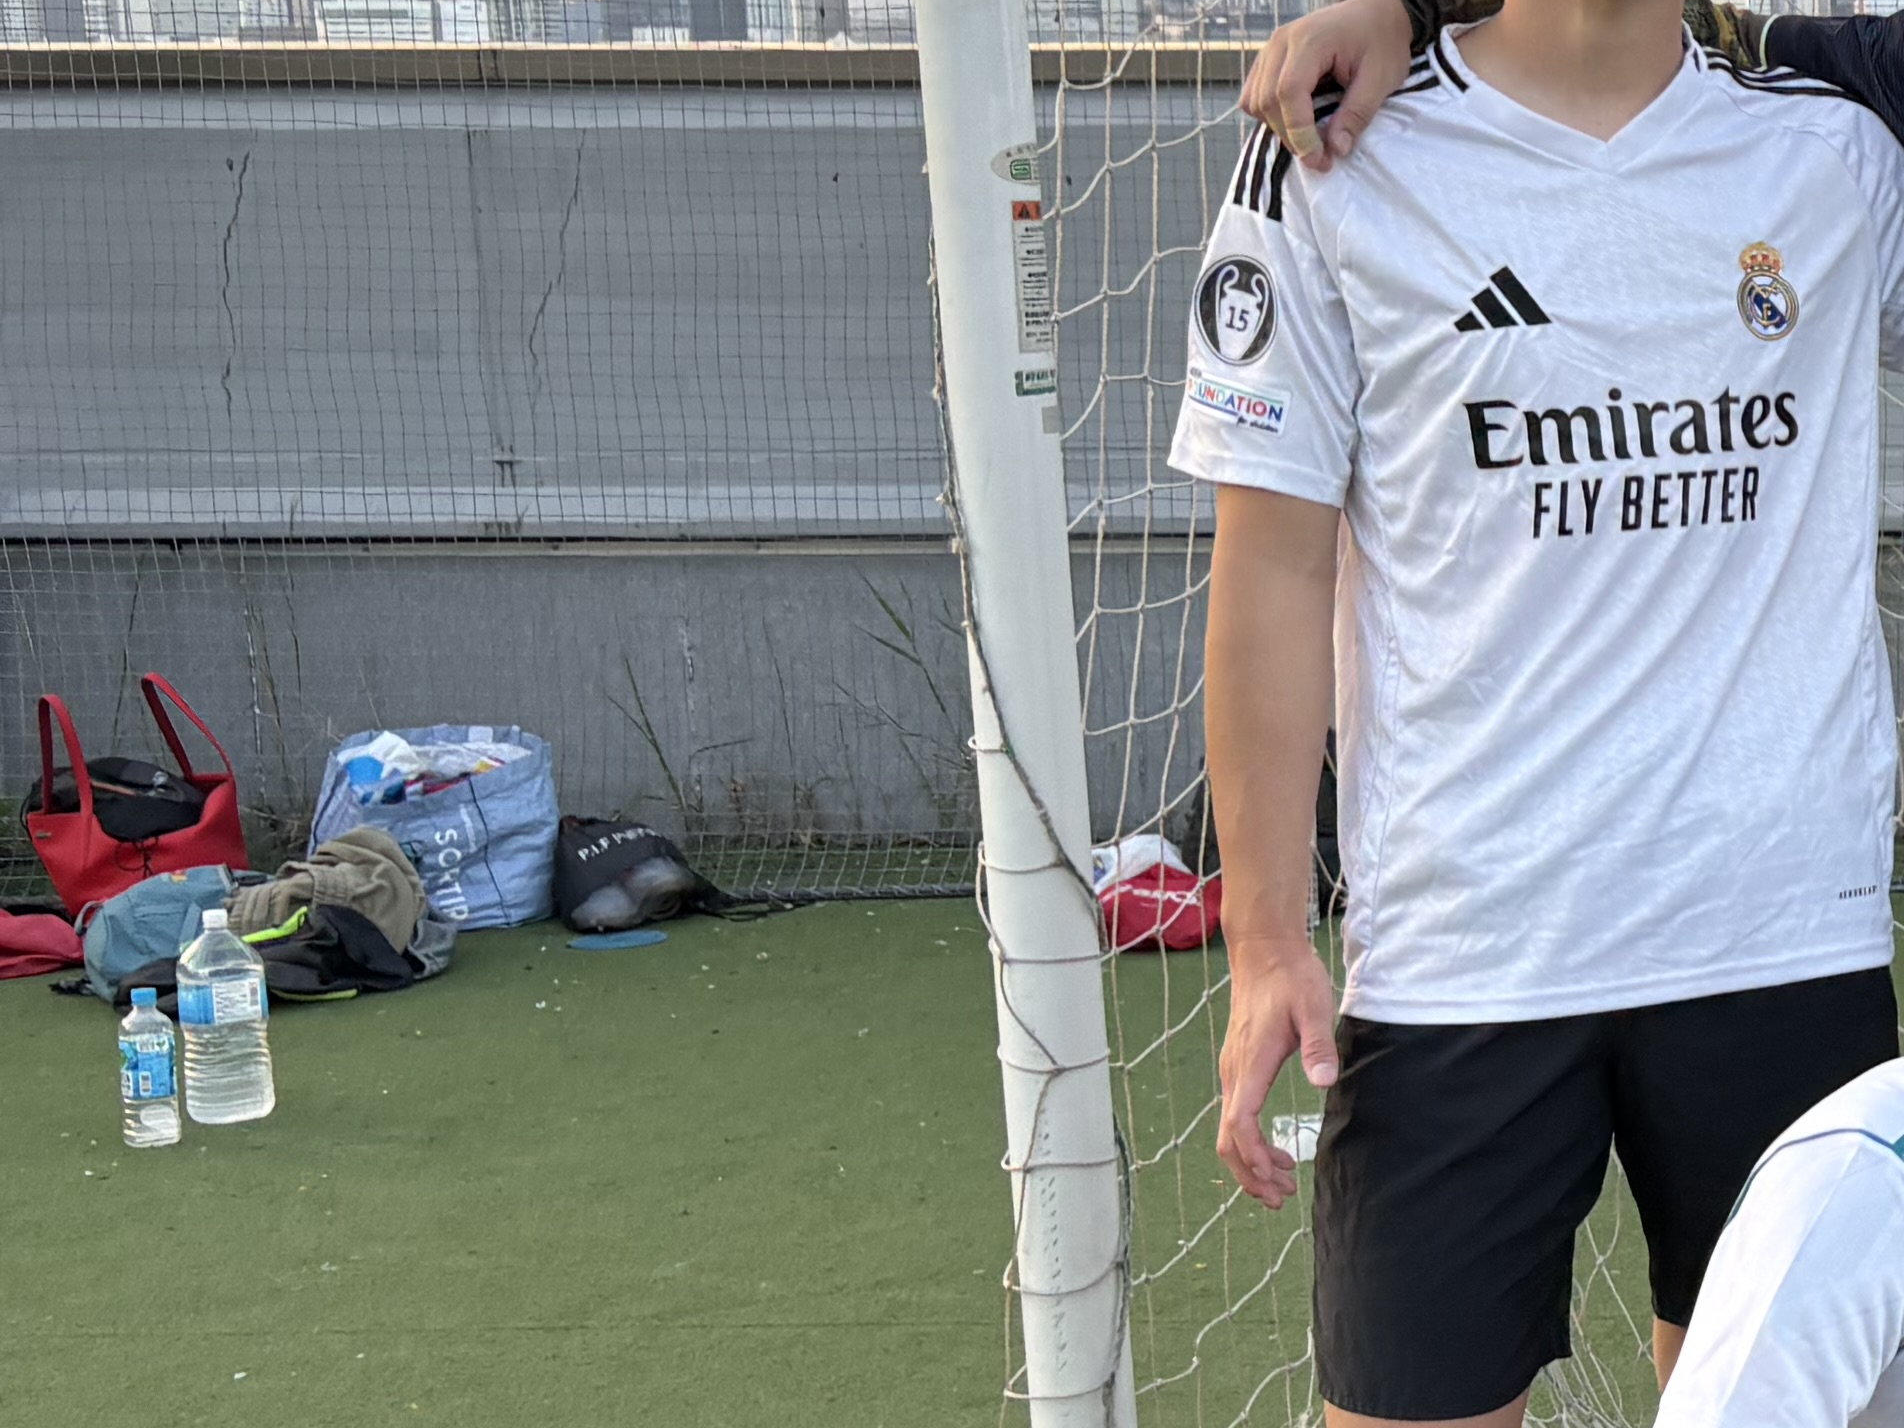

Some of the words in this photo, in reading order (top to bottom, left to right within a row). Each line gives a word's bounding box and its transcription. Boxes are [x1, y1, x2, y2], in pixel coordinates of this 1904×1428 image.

[1225, 305, 1250, 333] 15
[1187, 379, 1283, 422] UNDATION
[1463, 384, 1799, 471] Emirates
[1532, 478, 1601, 539] FLY
[1621, 465, 1760, 532] BETTER
